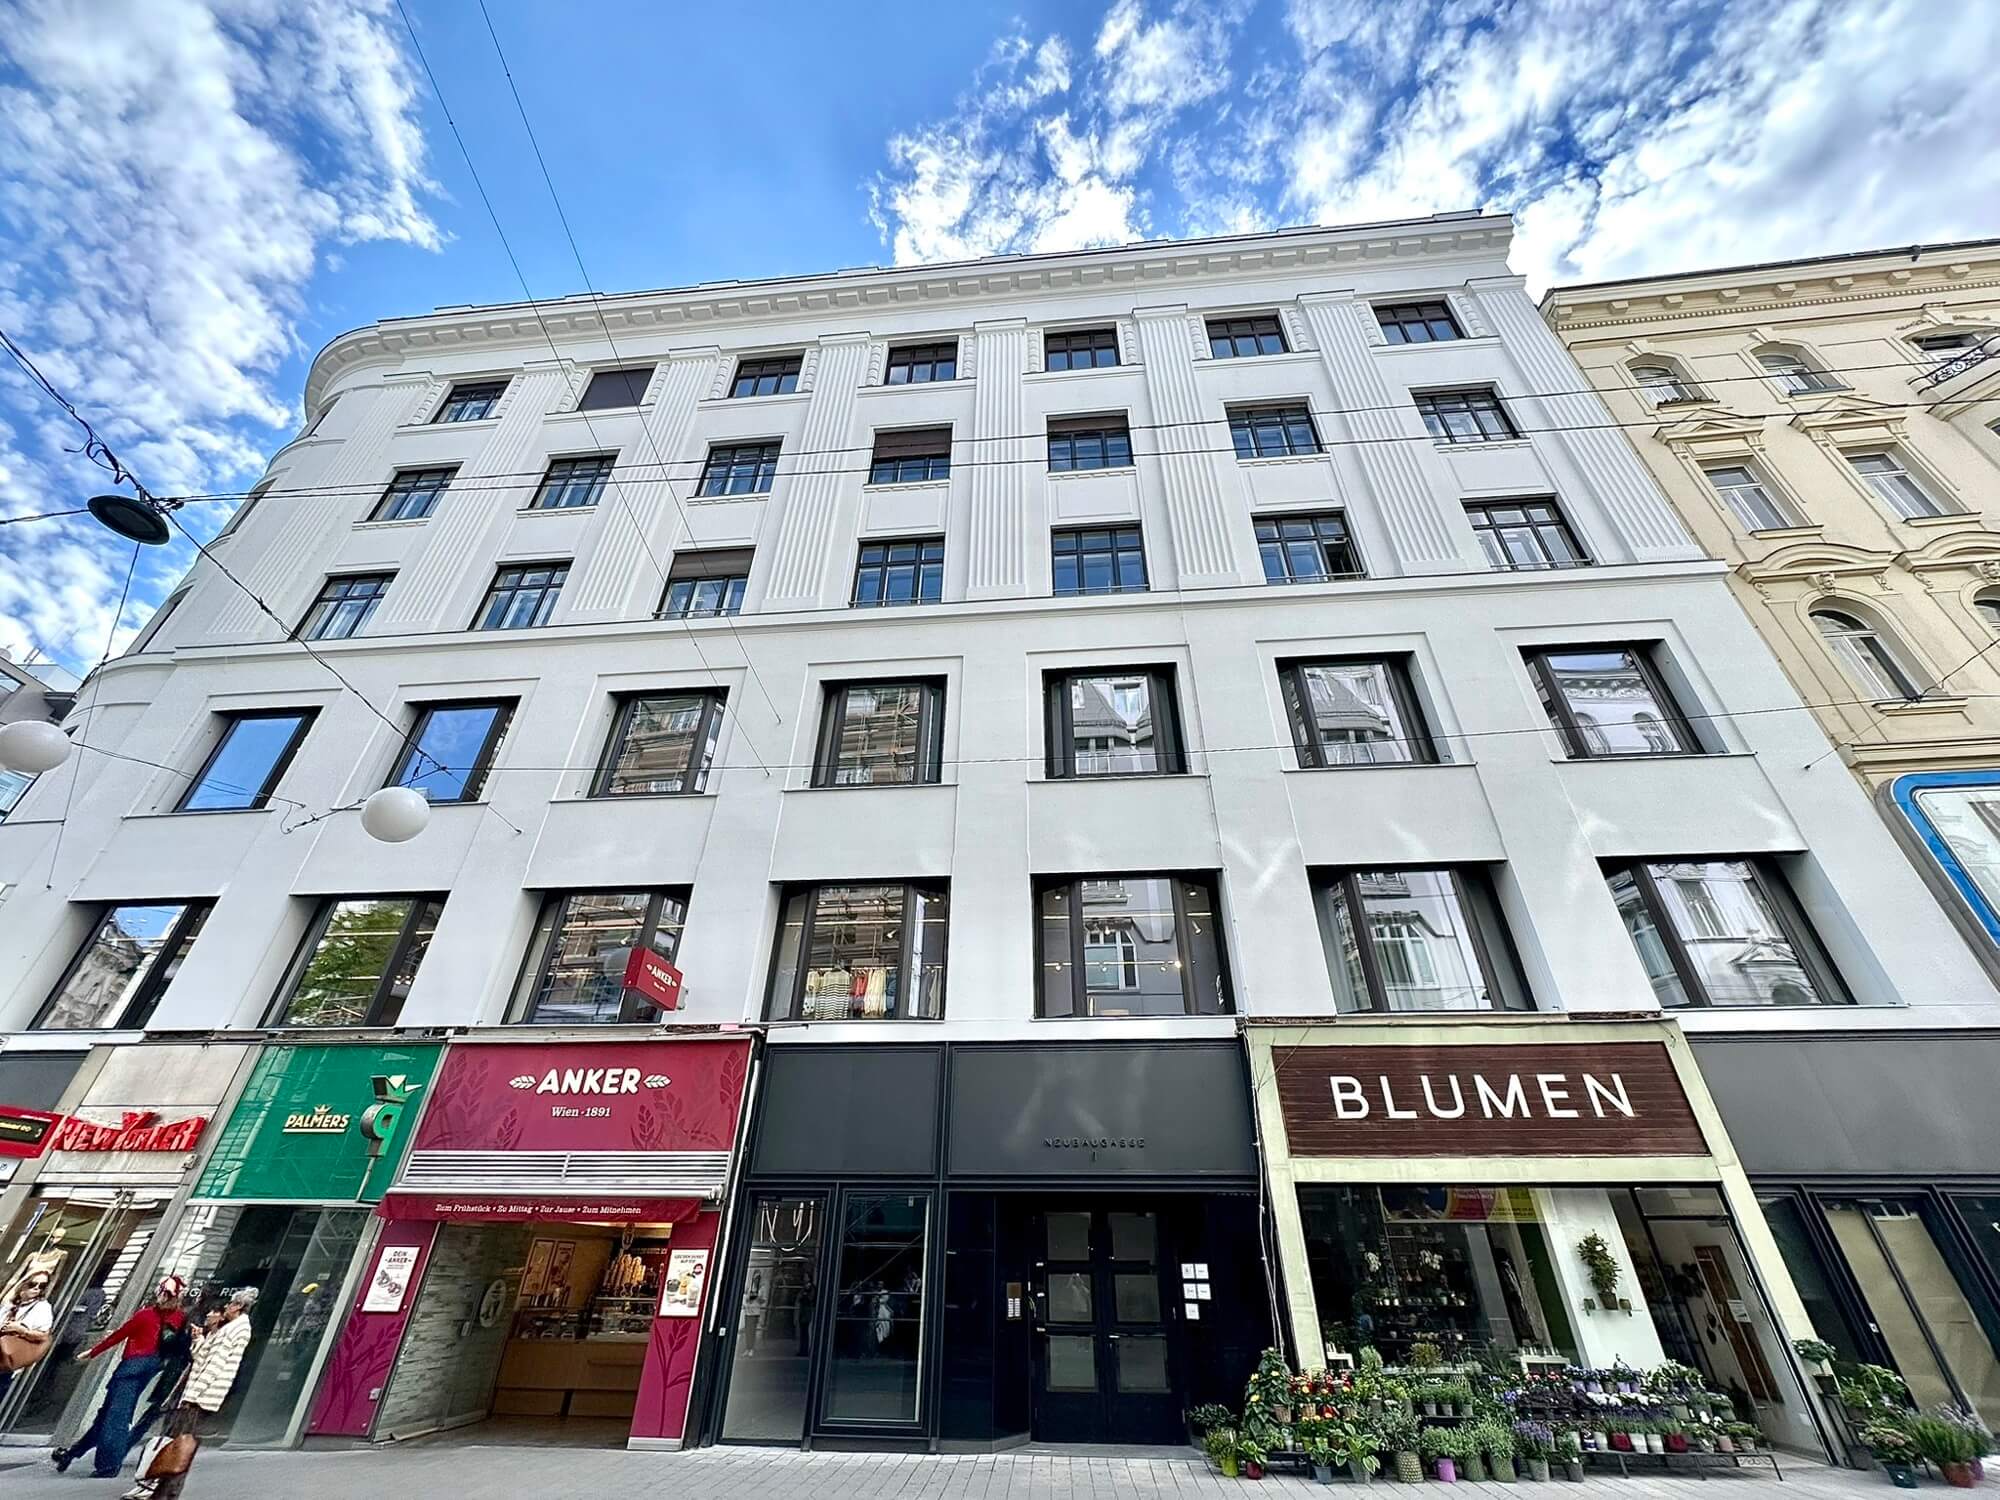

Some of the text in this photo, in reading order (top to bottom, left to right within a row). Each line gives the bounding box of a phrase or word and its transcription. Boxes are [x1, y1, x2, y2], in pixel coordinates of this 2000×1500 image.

[651, 965, 673, 986] ANKER
[536, 1068, 641, 1095] ANKER
[1330, 1073, 1635, 1119] BLUMEN
[551, 1106, 611, 1117] Wien 1891
[284, 1114, 350, 1128] PALMERS
[1043, 1137, 1145, 1149] NEUBAUGASSE
[435, 1203, 452, 1212] Zum
[453, 1204, 491, 1213] Frühstück
[497, 1204, 507, 1213] Zu
[508, 1205, 533, 1214] Mittag
[540, 1205, 553, 1213] Zur
[600, 1206, 642, 1214] Mitnehmen
